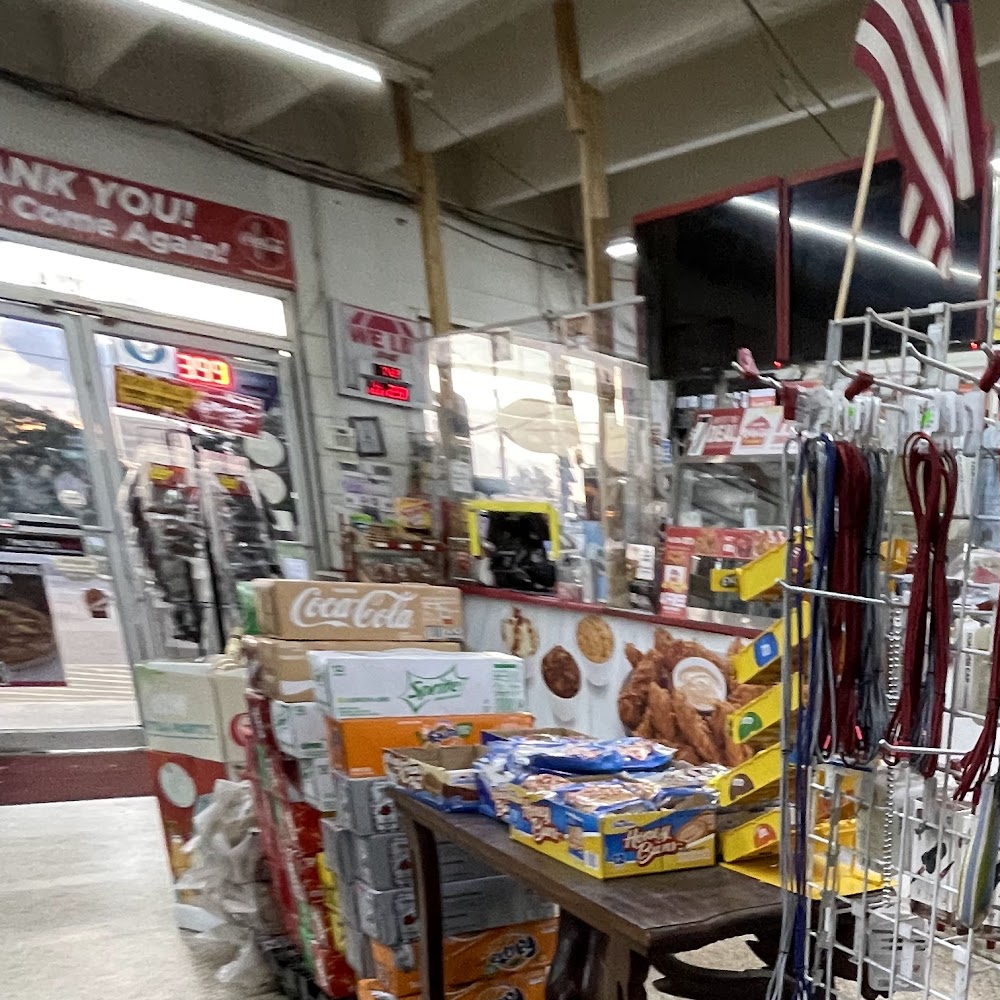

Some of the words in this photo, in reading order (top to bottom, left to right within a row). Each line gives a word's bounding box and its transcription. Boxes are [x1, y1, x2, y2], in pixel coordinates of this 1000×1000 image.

[10, 195, 118, 238] Come
[121, 221, 231, 264] Again!
[88, 176, 197, 228] YOU!
